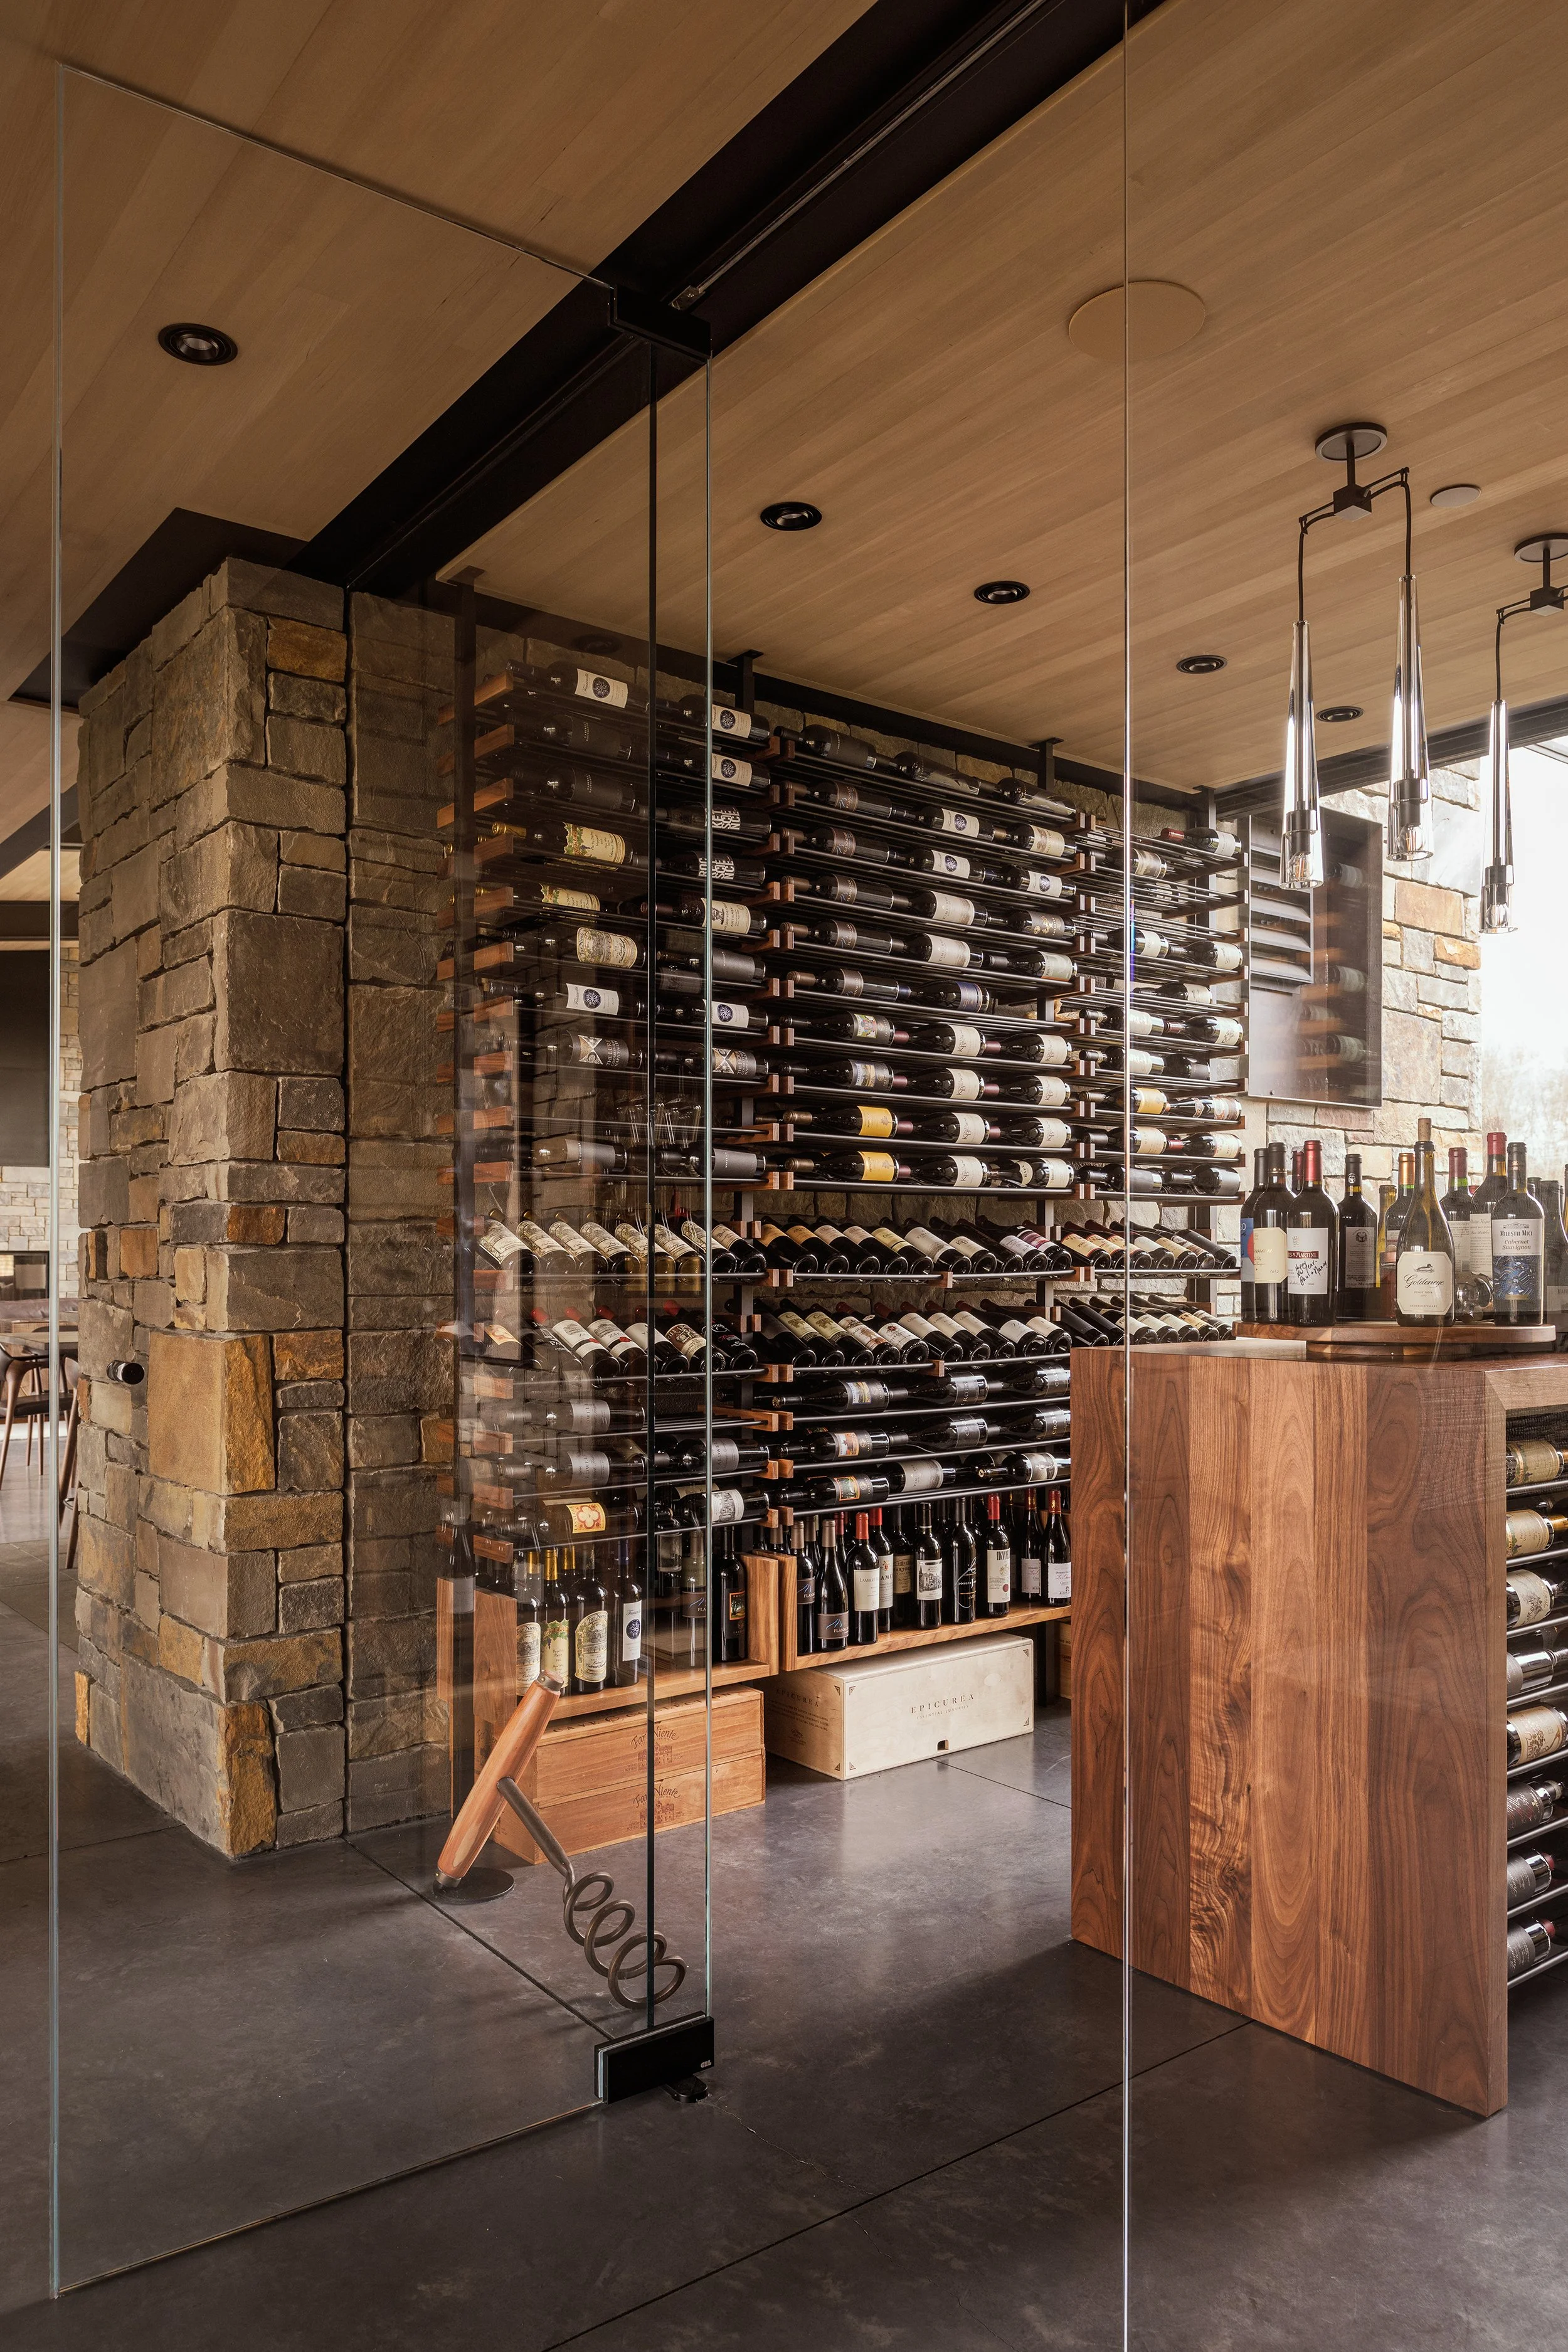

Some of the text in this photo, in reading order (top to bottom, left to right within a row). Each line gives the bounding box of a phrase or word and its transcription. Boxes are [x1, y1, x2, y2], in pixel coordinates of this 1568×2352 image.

[1404, 1274, 1444, 1289] Goldeneye
[911, 1694, 973, 1714] EPICUREA
[631, 1734, 647, 1749] Far
